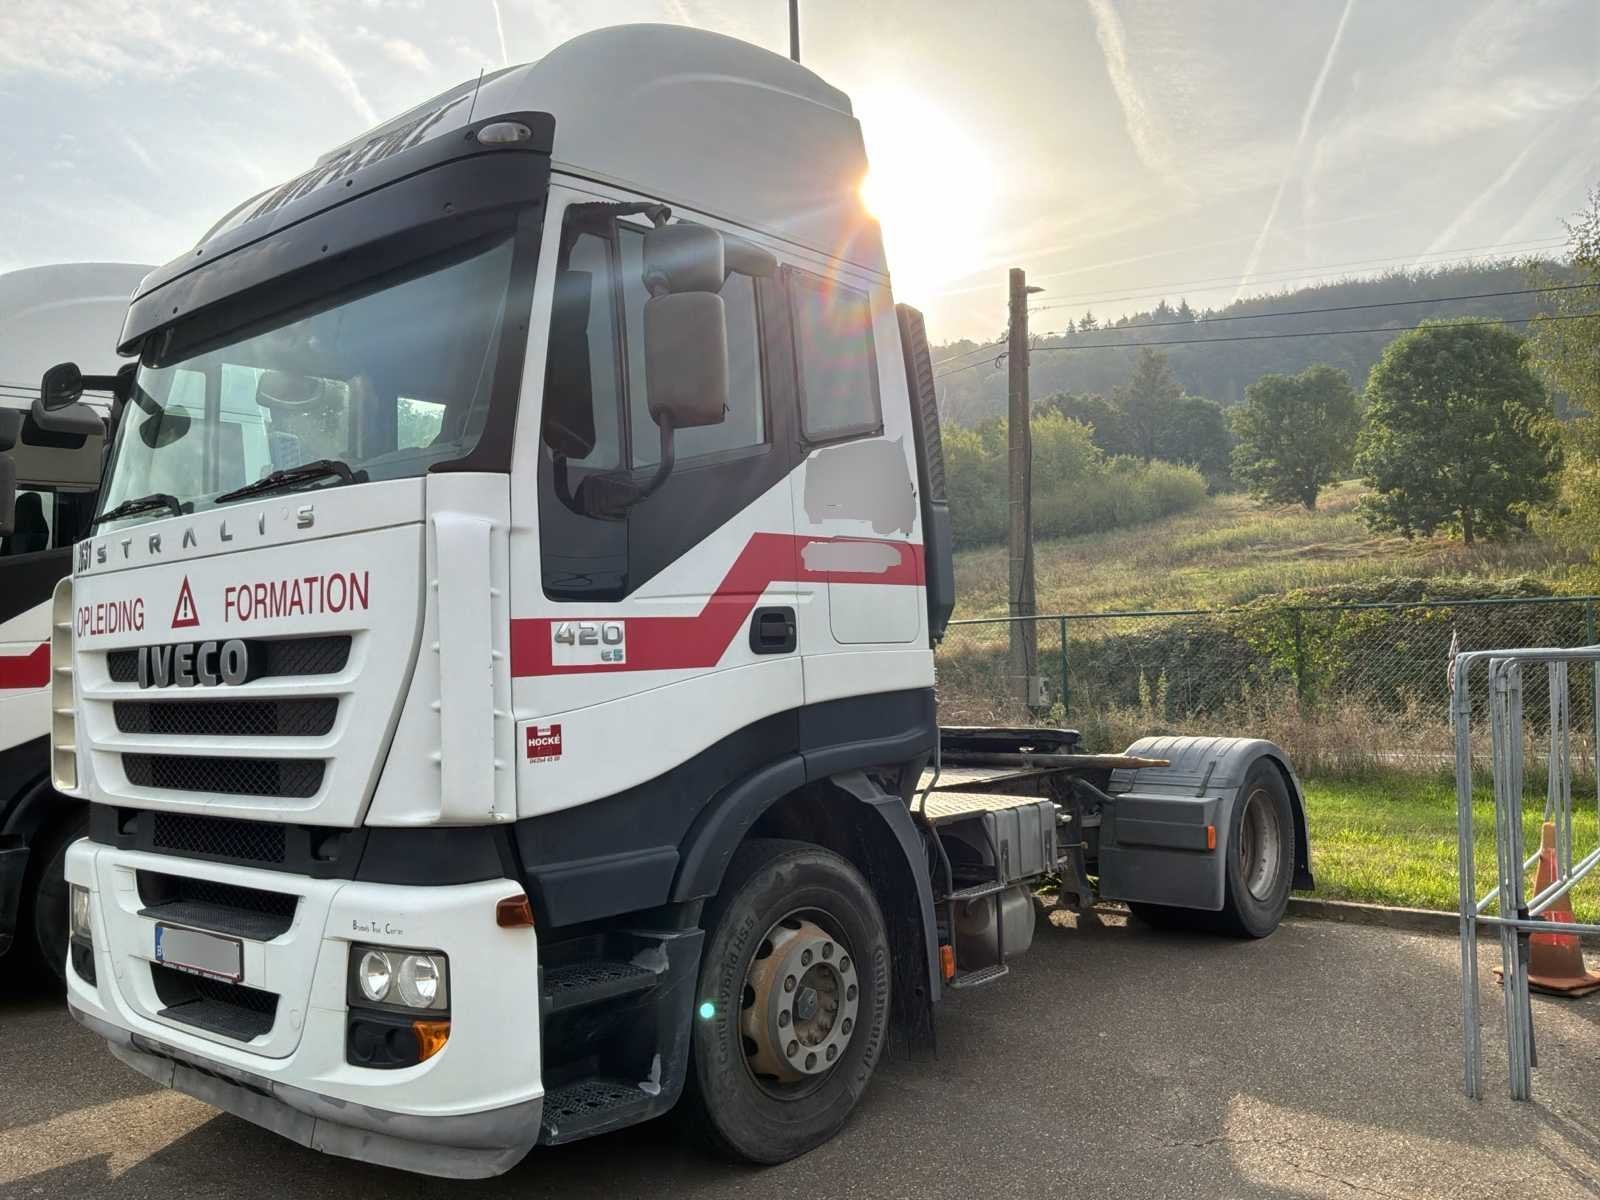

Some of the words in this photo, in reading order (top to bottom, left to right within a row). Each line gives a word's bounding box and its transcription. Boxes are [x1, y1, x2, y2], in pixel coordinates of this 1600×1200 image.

[96, 504, 315, 564] STRALIS
[77, 598, 144, 638] OPLEIDING
[225, 571, 369, 623] FORMATION
[554, 622, 624, 647] 420
[137, 639, 248, 690] IVECO
